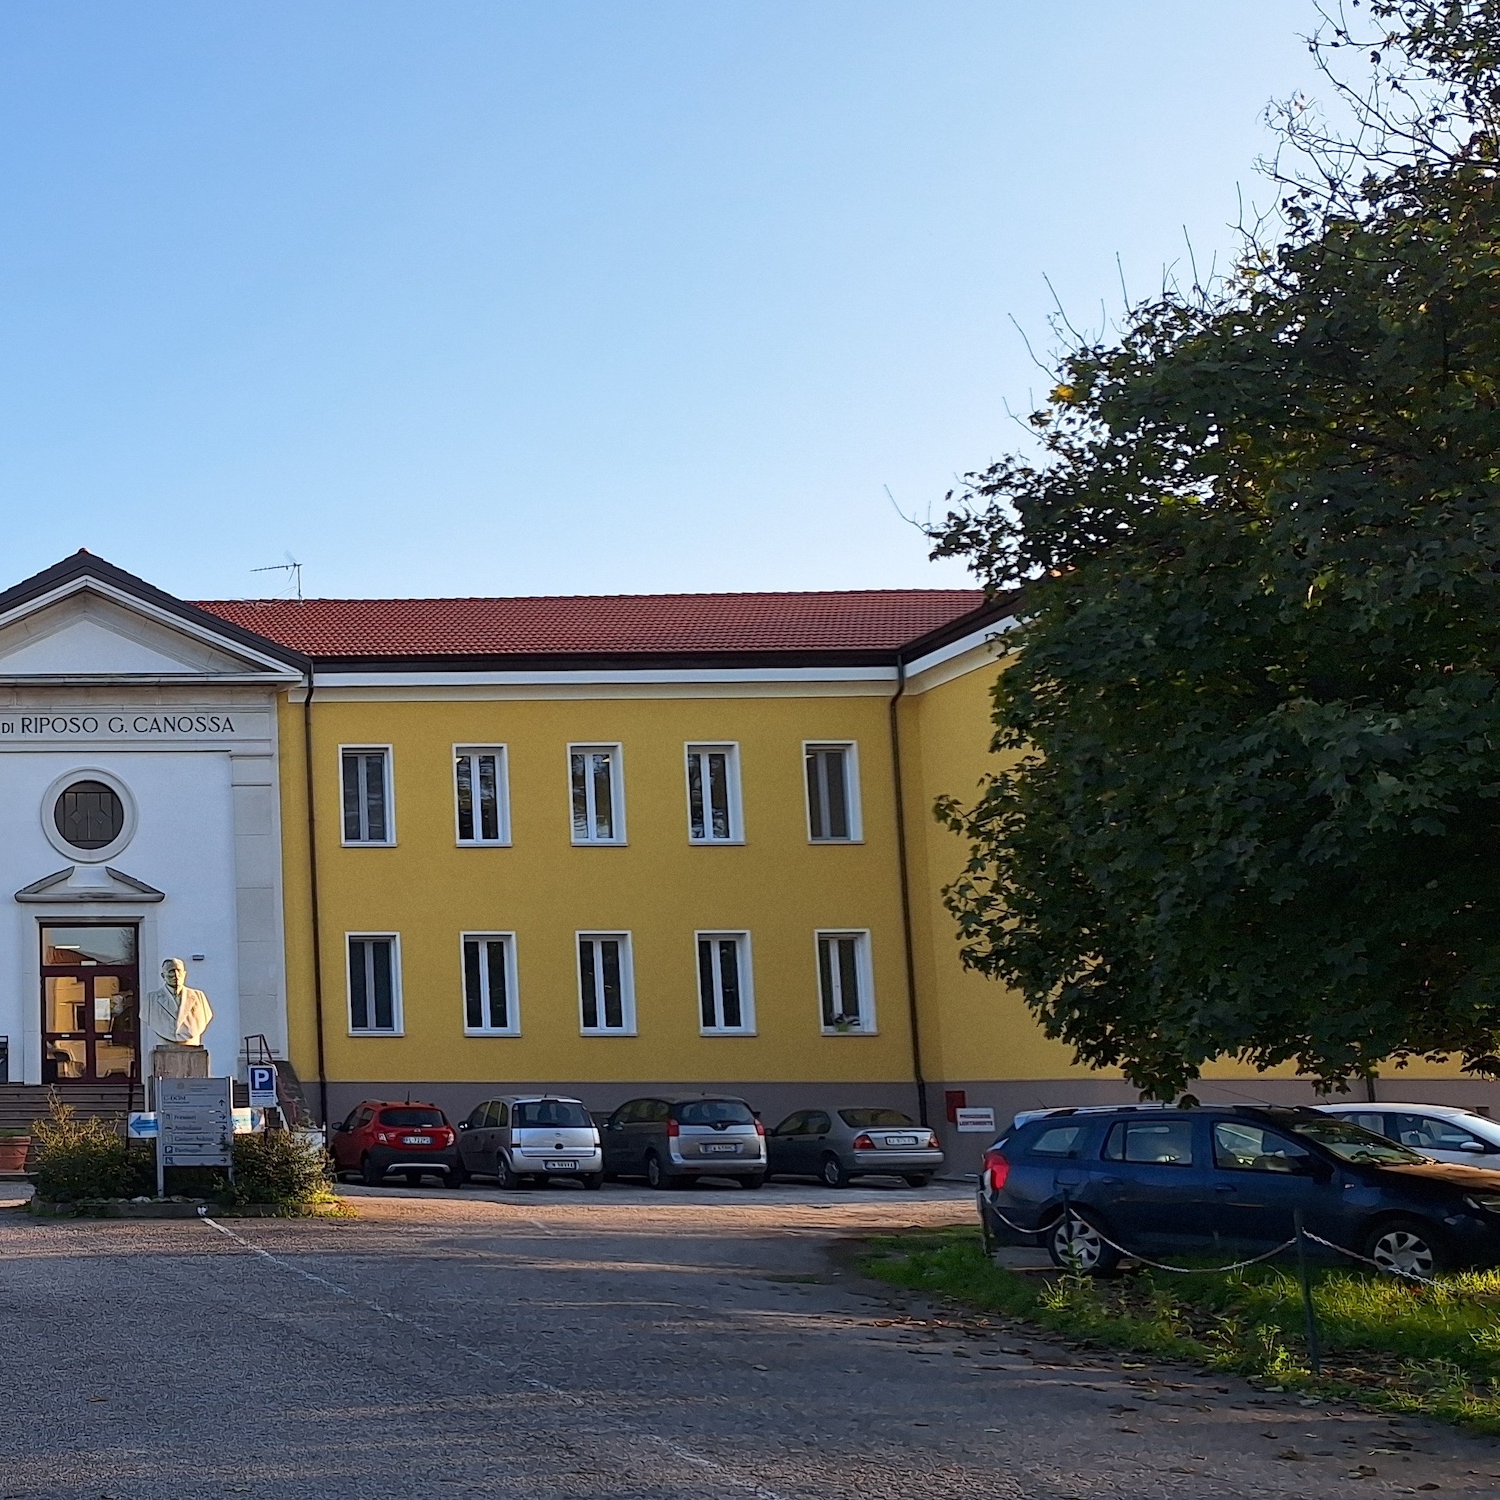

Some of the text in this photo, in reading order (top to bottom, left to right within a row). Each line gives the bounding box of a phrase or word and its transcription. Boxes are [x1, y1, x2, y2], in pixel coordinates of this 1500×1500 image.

[1, 722, 14, 734] DI
[21, 717, 99, 734] RIPOSO
[108, 716, 128, 733] G.
[133, 716, 235, 733] CANOSSA
[254, 1069, 270, 1089] P
